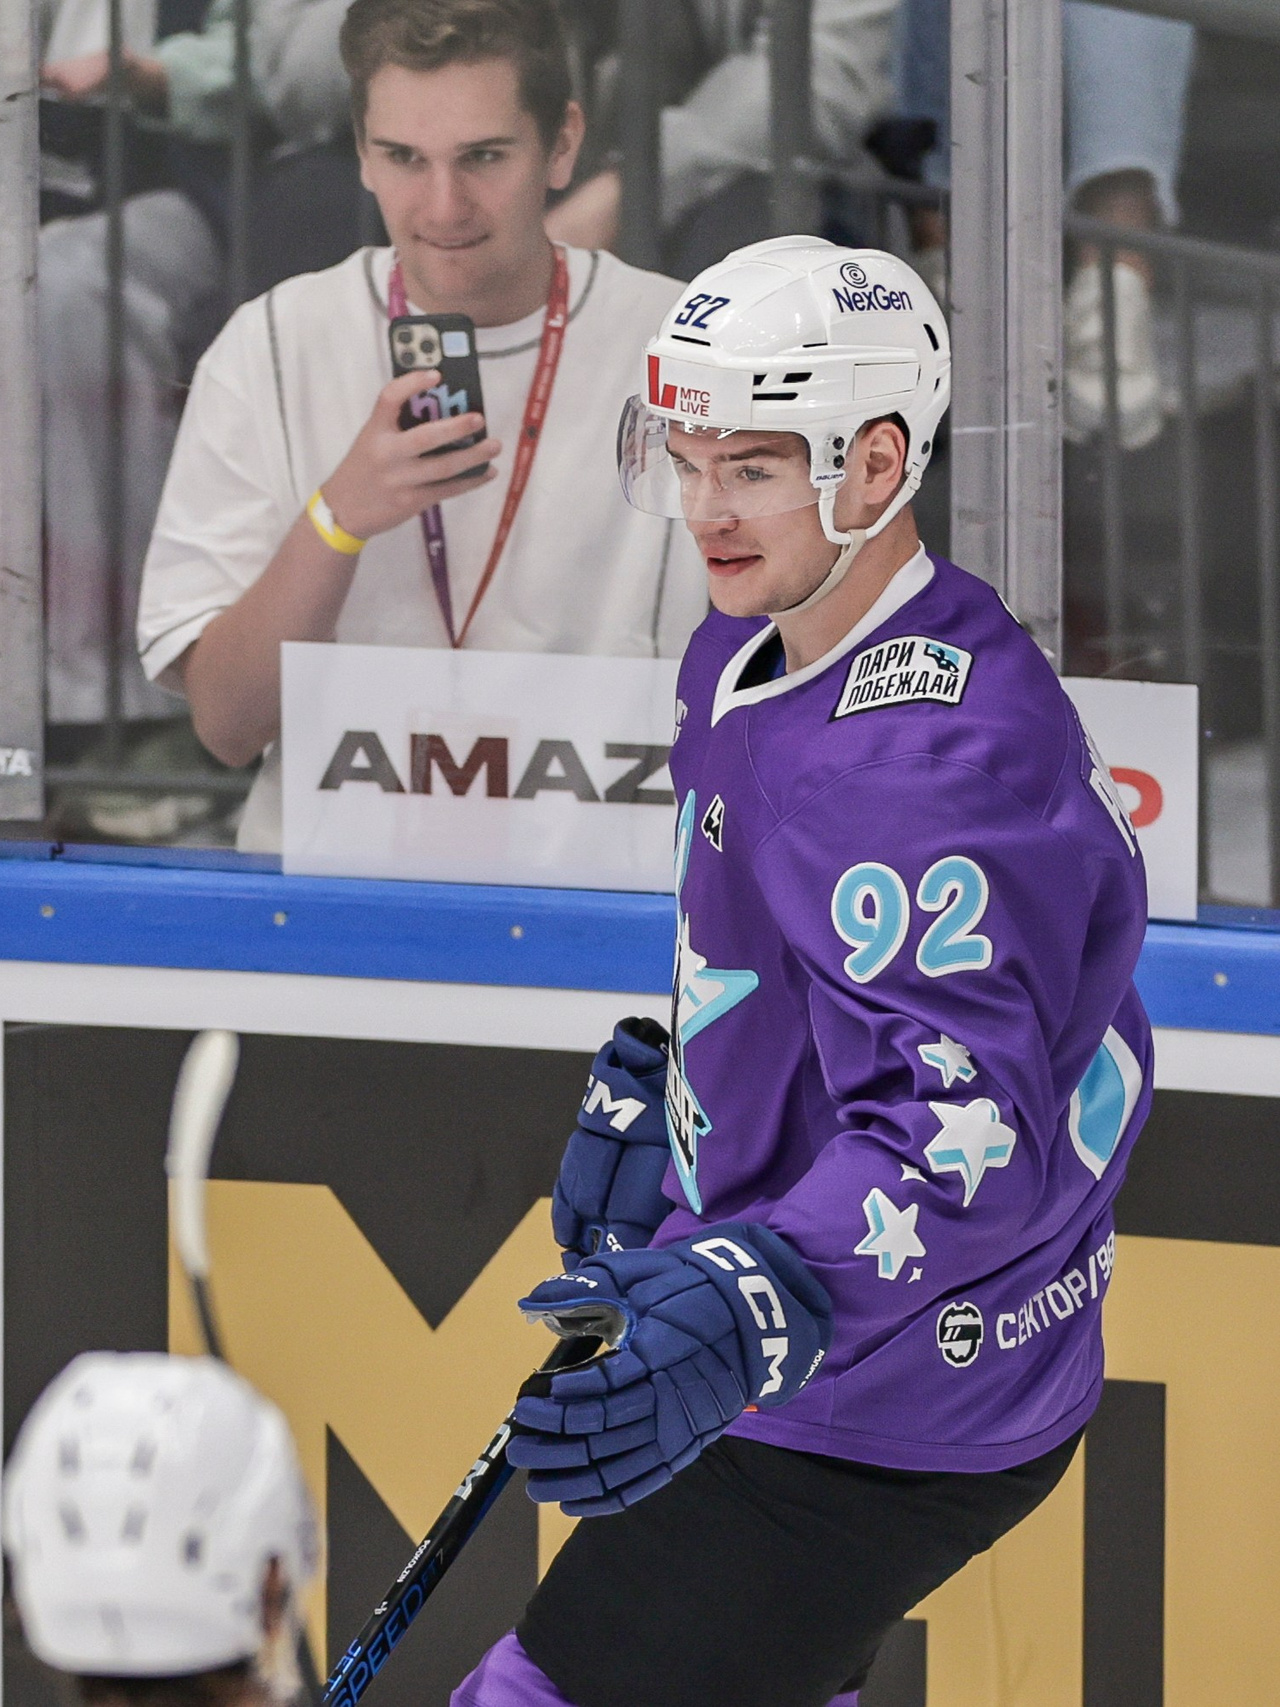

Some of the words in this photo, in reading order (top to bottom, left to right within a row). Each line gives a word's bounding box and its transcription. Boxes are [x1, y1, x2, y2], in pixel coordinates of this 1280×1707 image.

[674, 293, 731, 330] 92
[832, 284, 913, 313] NexGen
[681, 401, 709, 417] LIVE
[854, 640, 916, 682] ПАРИ
[845, 670, 959, 710] ПОБЕЖДАЙ
[830, 855, 993, 983] 92
[691, 1237, 788, 1398] CCM
